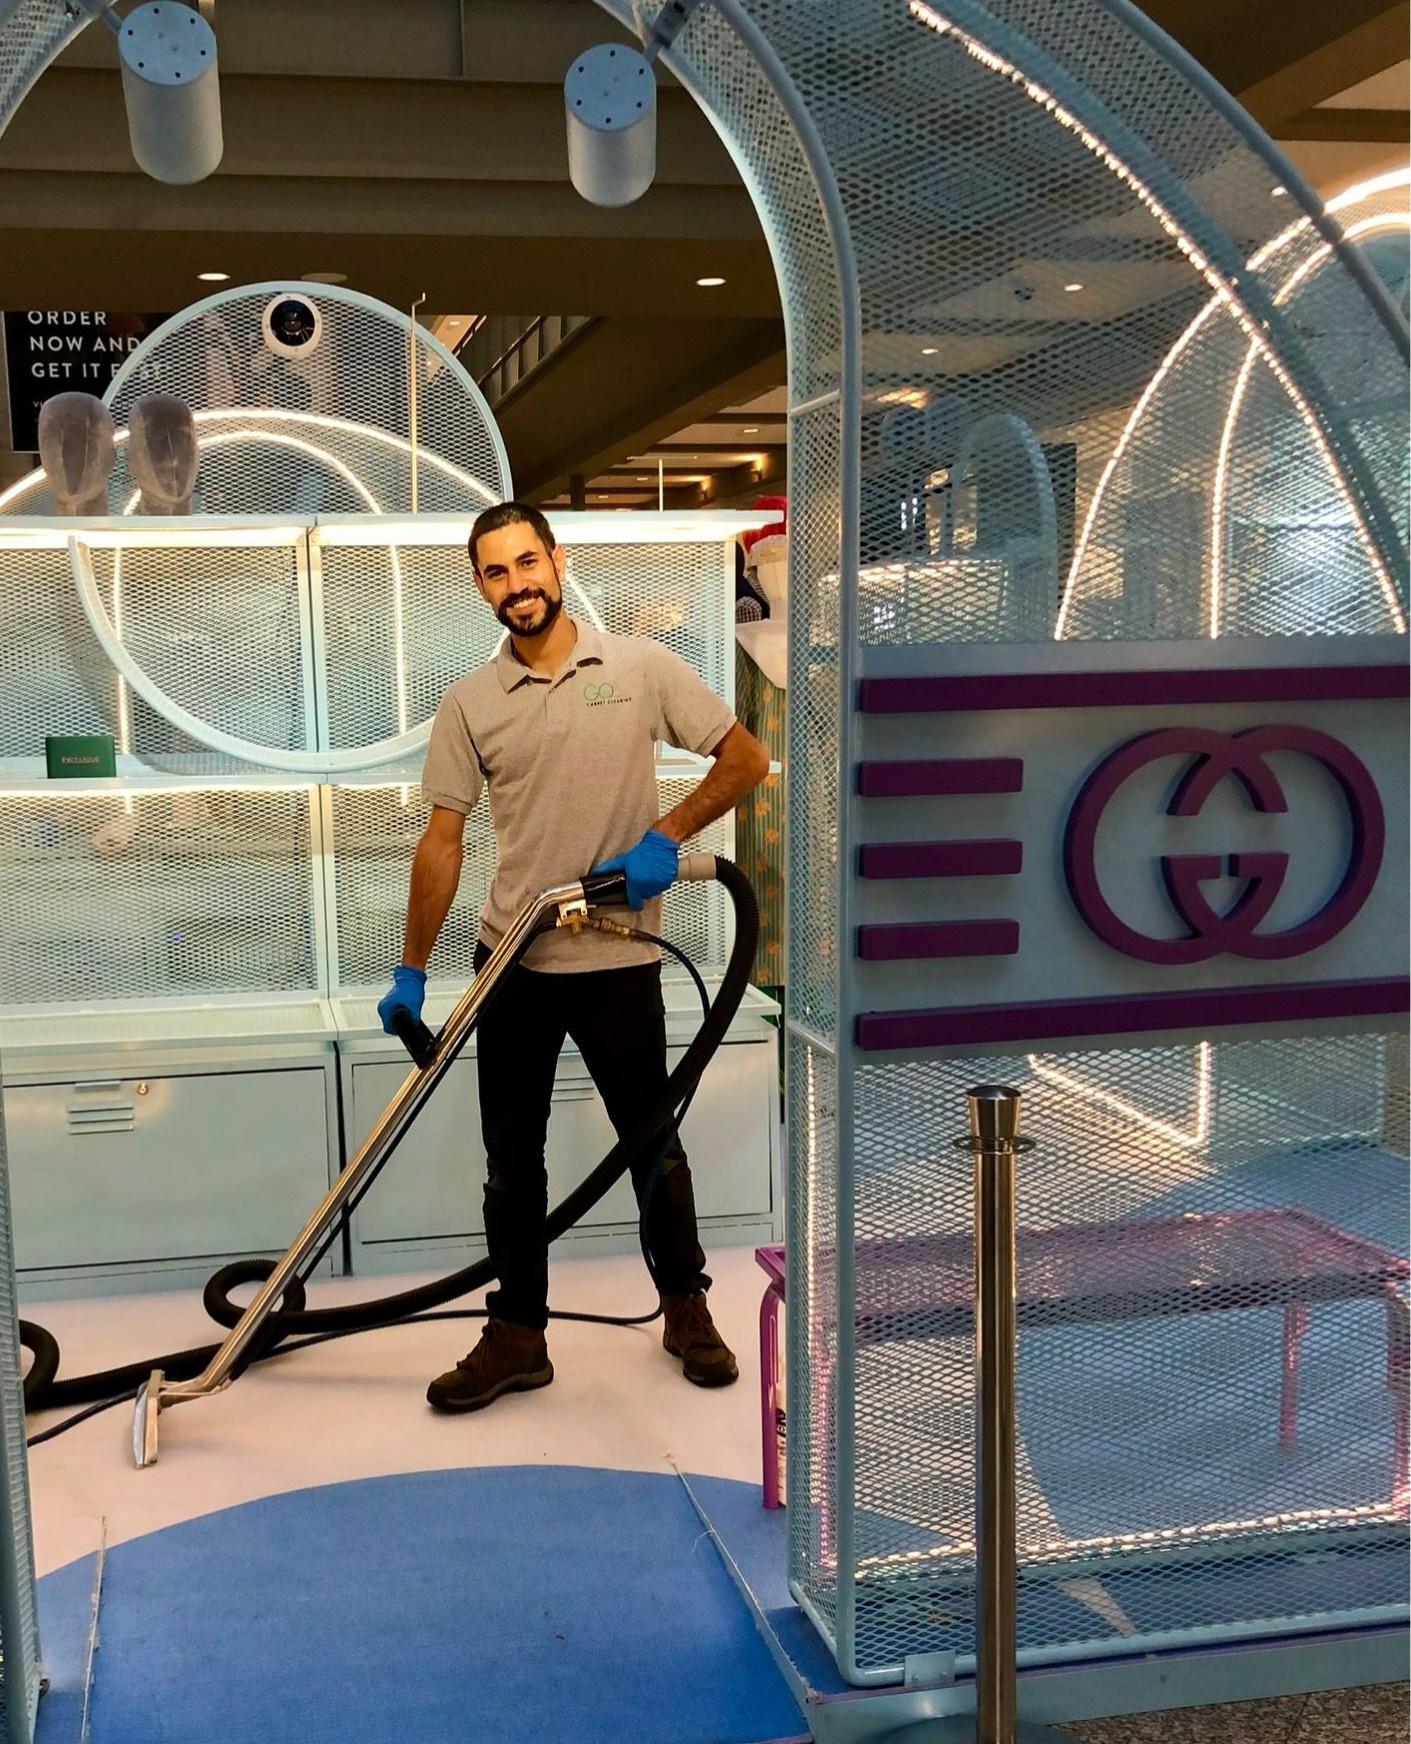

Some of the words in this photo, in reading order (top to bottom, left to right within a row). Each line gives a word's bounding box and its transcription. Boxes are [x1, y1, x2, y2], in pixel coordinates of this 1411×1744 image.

[27, 311, 107, 326] ORDER
[30, 336, 83, 352] NOW
[93, 337, 141, 352] AND
[31, 362, 72, 378] GET
[83, 363, 101, 378] IT
[583, 682, 614, 701] GO
[61, 756, 99, 764] EXCLUSIVE
